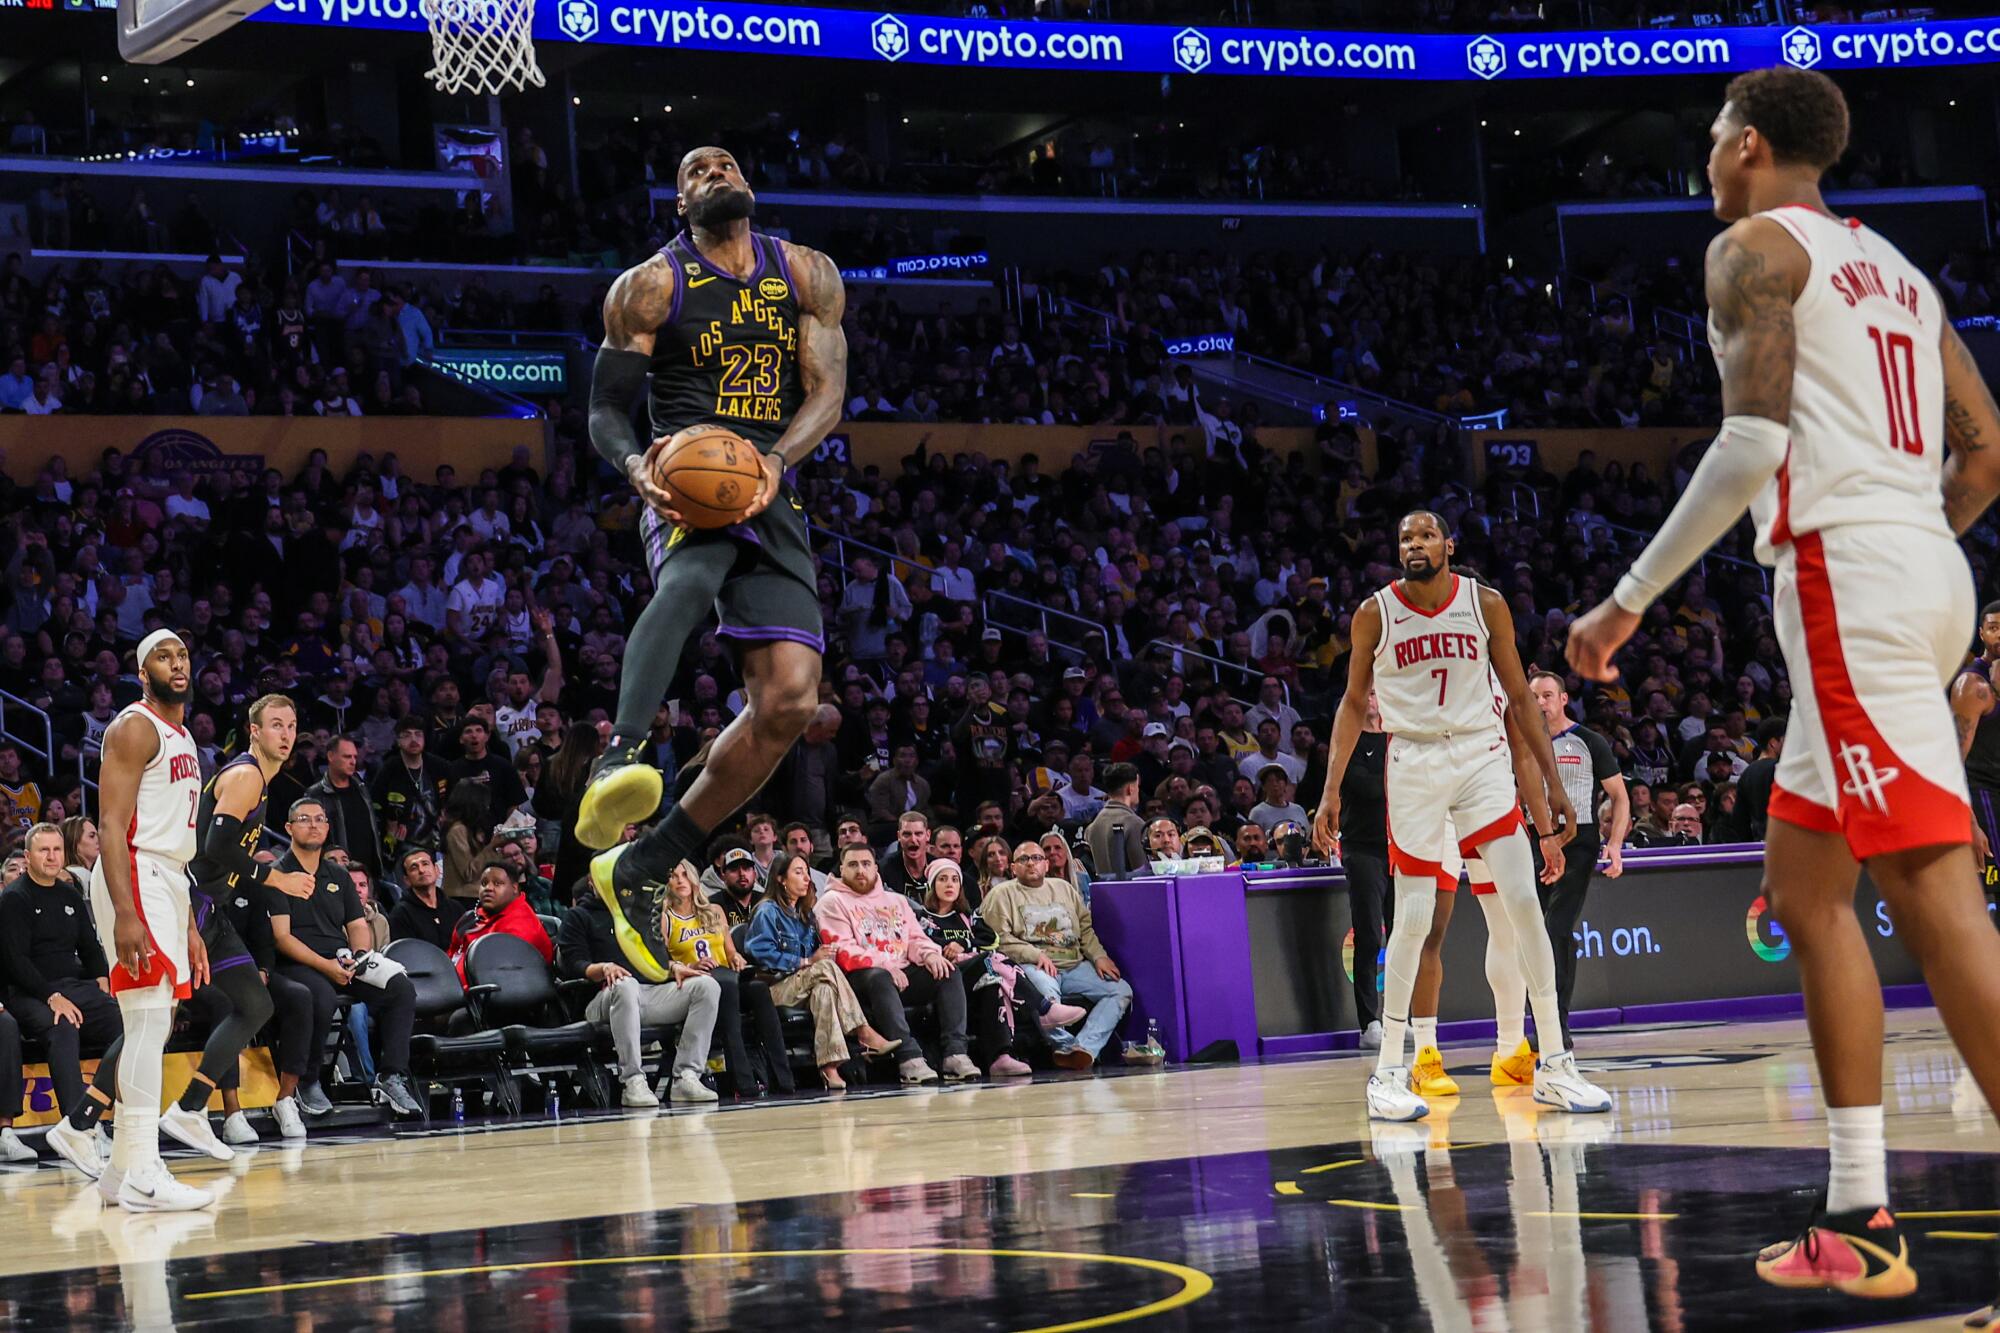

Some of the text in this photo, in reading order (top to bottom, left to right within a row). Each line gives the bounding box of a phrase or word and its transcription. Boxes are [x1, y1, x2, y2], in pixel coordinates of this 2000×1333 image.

[610, 4, 821, 48] crypto.com
[919, 24, 1124, 63] crypto.com
[1221, 34, 1417, 74] crypto.com
[1517, 36, 1730, 75] crypto.com
[1830, 260, 1889, 308] SMITH
[690, 320, 723, 367] LOS
[719, 343, 783, 397] 23
[714, 396, 782, 421] LAKERS
[1866, 324, 1924, 457] 10
[470, 614, 491, 632] 24
[1393, 632, 1478, 670] ROCKETS
[1431, 667, 1449, 707] 7
[695, 940, 709, 960] 8
[1611, 926, 1662, 956] on.
